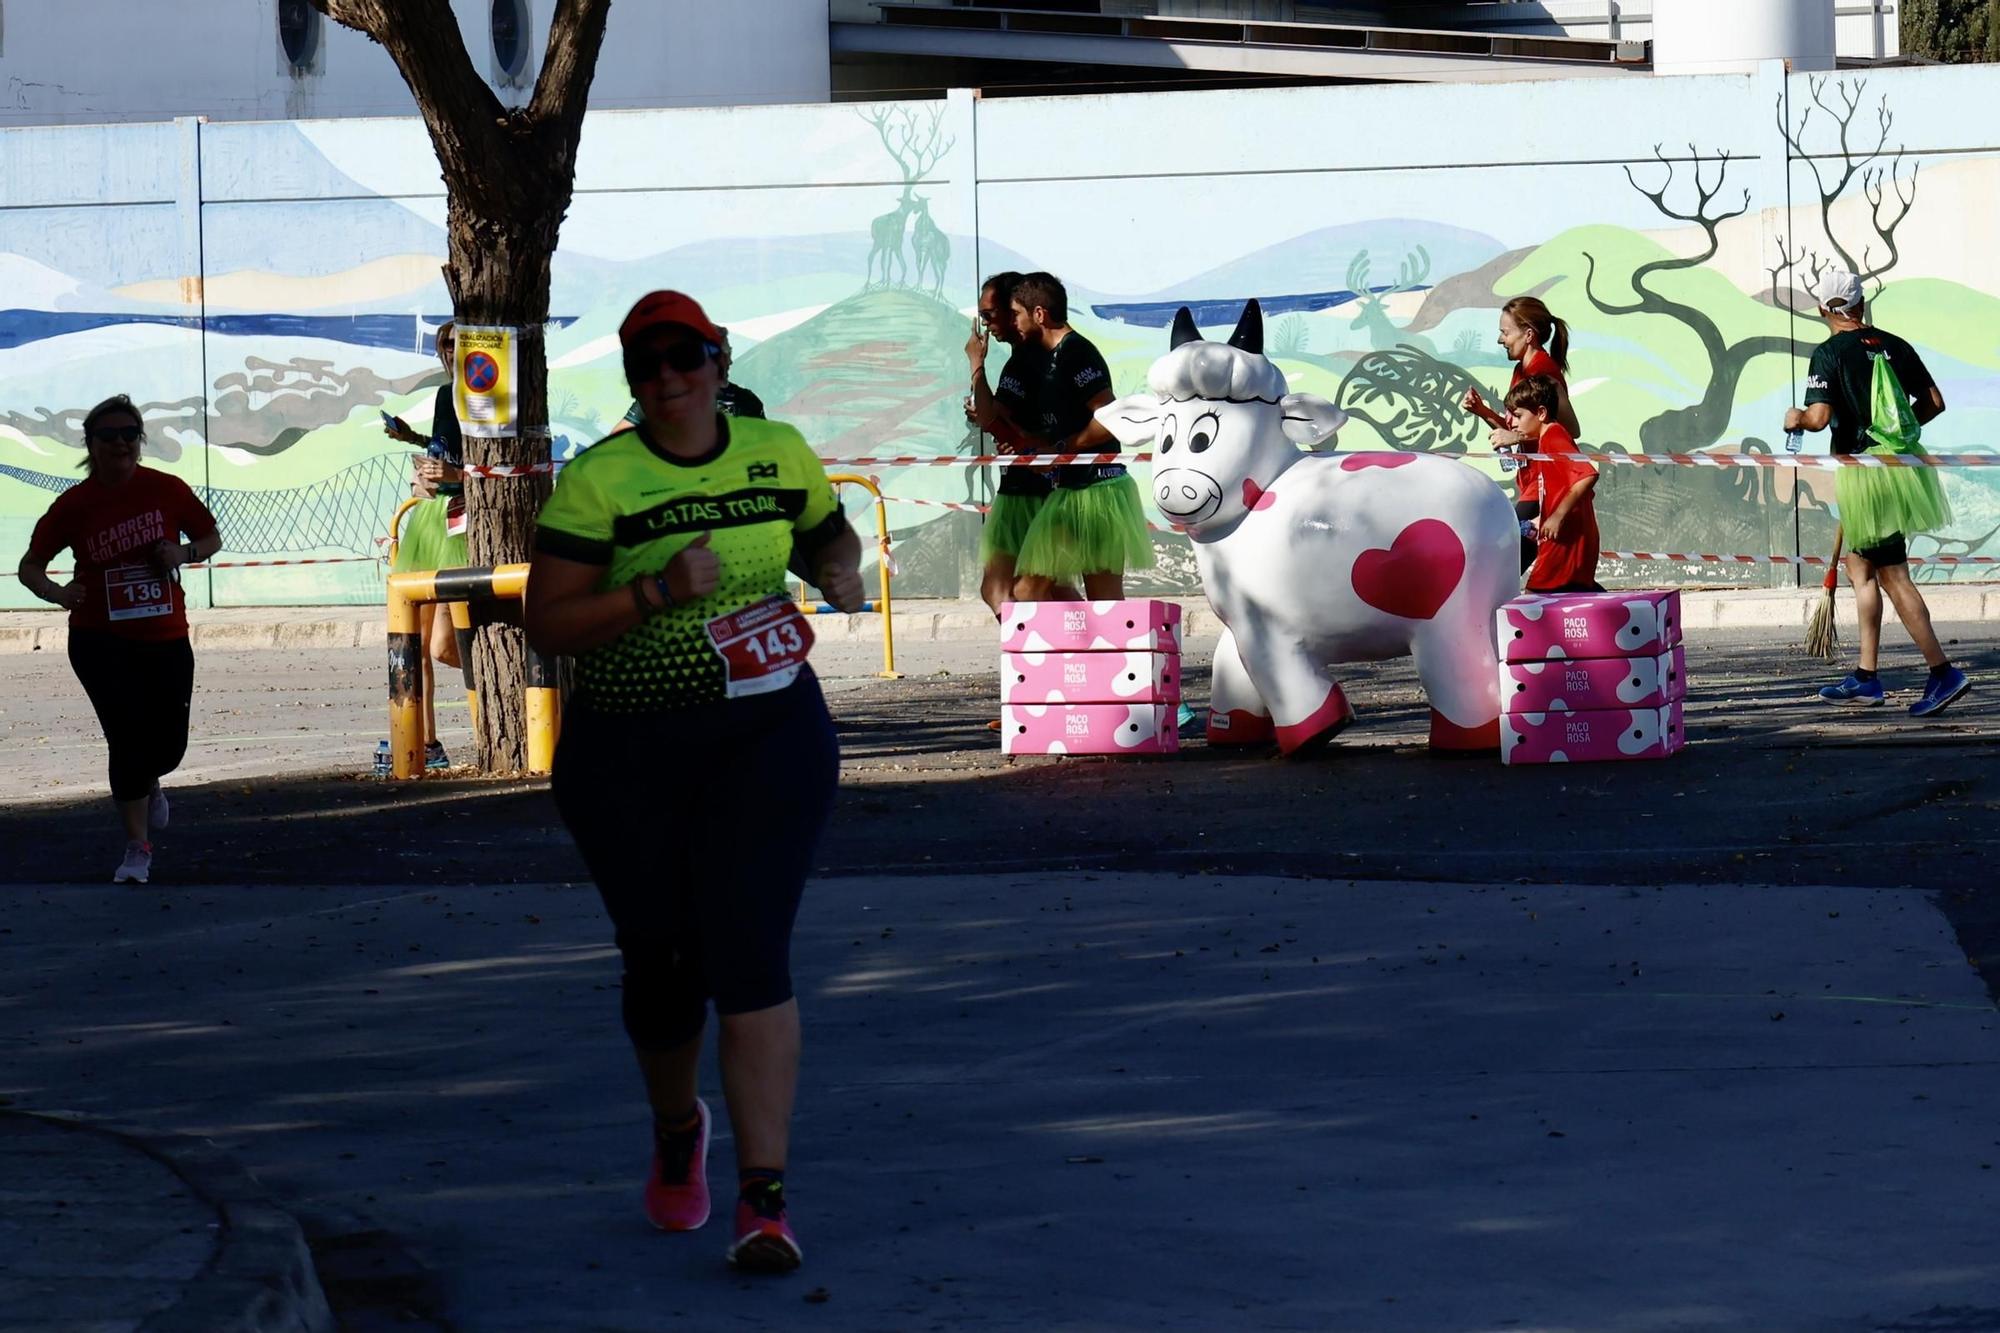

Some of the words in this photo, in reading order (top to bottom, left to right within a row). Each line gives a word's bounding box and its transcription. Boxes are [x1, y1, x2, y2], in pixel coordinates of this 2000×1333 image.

[647, 502, 722, 530] LATAS
[86, 535, 96, 553] II
[98, 509, 164, 546] CARRERA
[91, 523, 165, 563] SOLIDARIA
[123, 582, 162, 602] 136
[1064, 611, 1086, 621] PACO
[1064, 621, 1087, 631] ROSA
[1563, 617, 1586, 628] PACO
[1564, 628, 1588, 638] ROSA
[745, 622, 803, 664] 143
[1064, 663, 1086, 673] PACO
[1064, 674, 1087, 683] ROSA
[1565, 671, 1588, 681] PACO
[1566, 681, 1590, 691] ROSA
[1066, 715, 1088, 724] PACO
[1066, 725, 1089, 735] ROSA
[1566, 722, 1589, 732] PACO
[1567, 733, 1590, 743] ROSA
